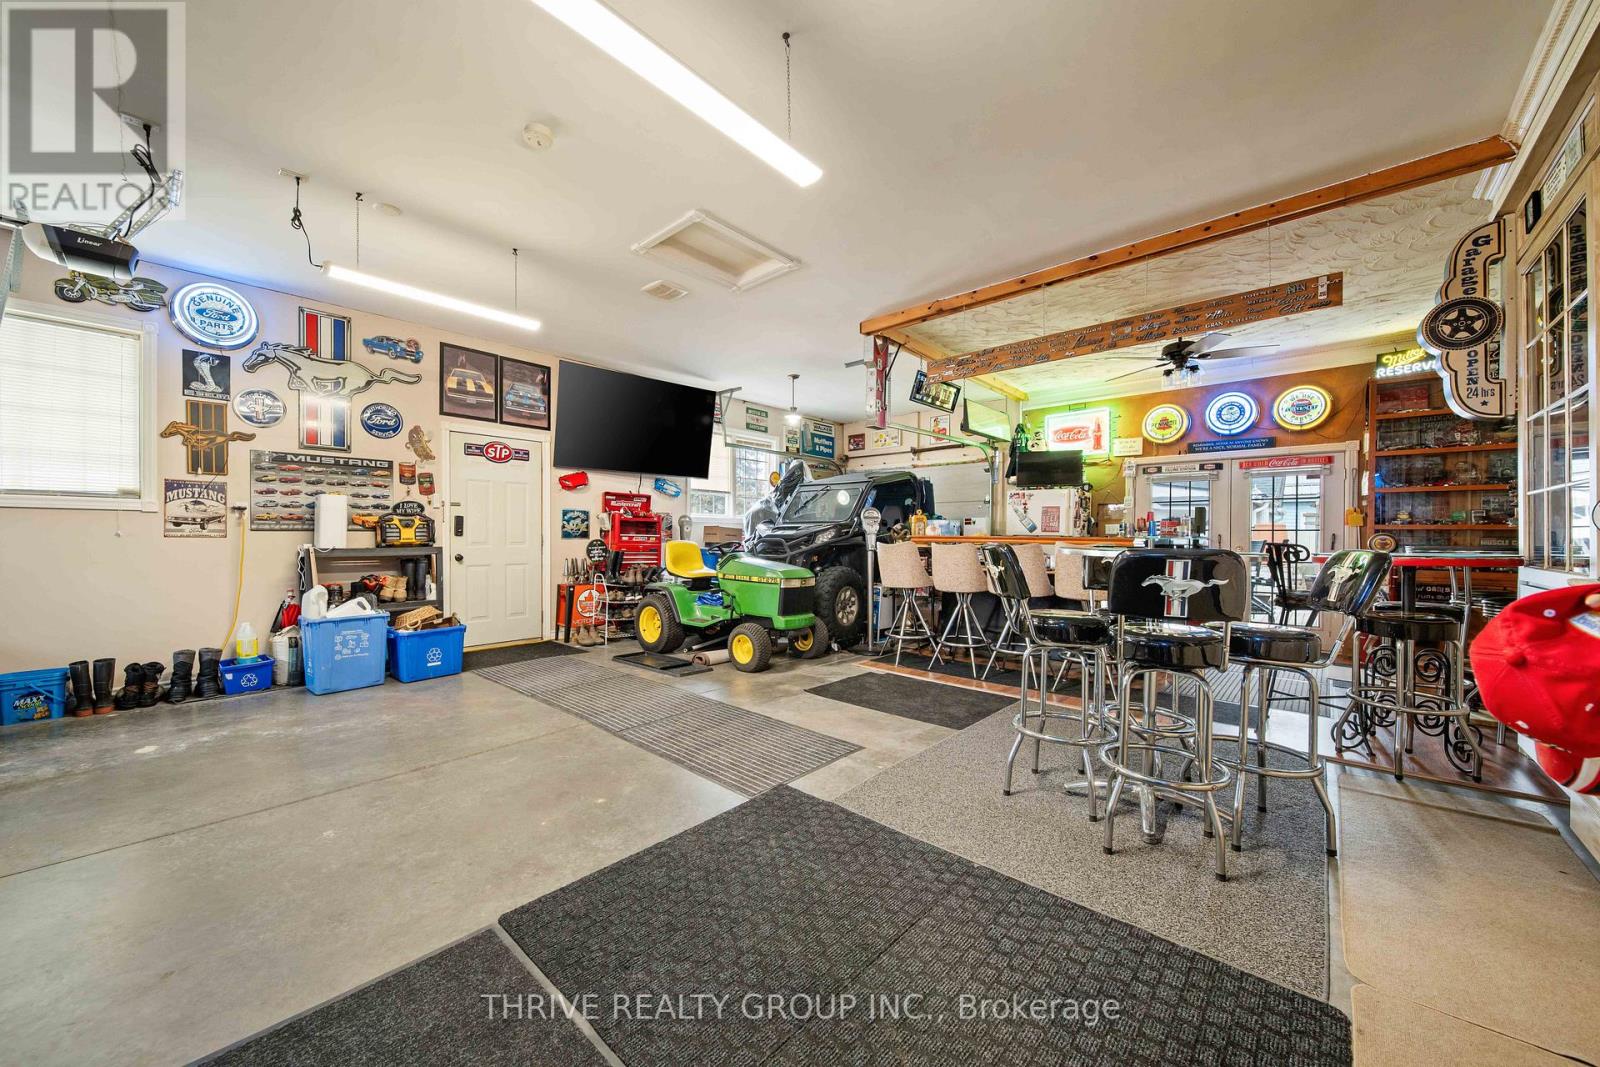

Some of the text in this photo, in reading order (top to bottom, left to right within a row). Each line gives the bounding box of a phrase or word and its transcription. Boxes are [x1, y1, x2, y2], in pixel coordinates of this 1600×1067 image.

[193, 293, 240, 314] GENUINE
[203, 308, 231, 321] Ford
[200, 320, 234, 331] PARTS
[1466, 386, 1496, 399] 24 hrs
[367, 414, 396, 426] Ford
[487, 444, 510, 459] STP
[286, 454, 389, 468] MUSTANG
[166, 487, 225, 504] MUSTANG
